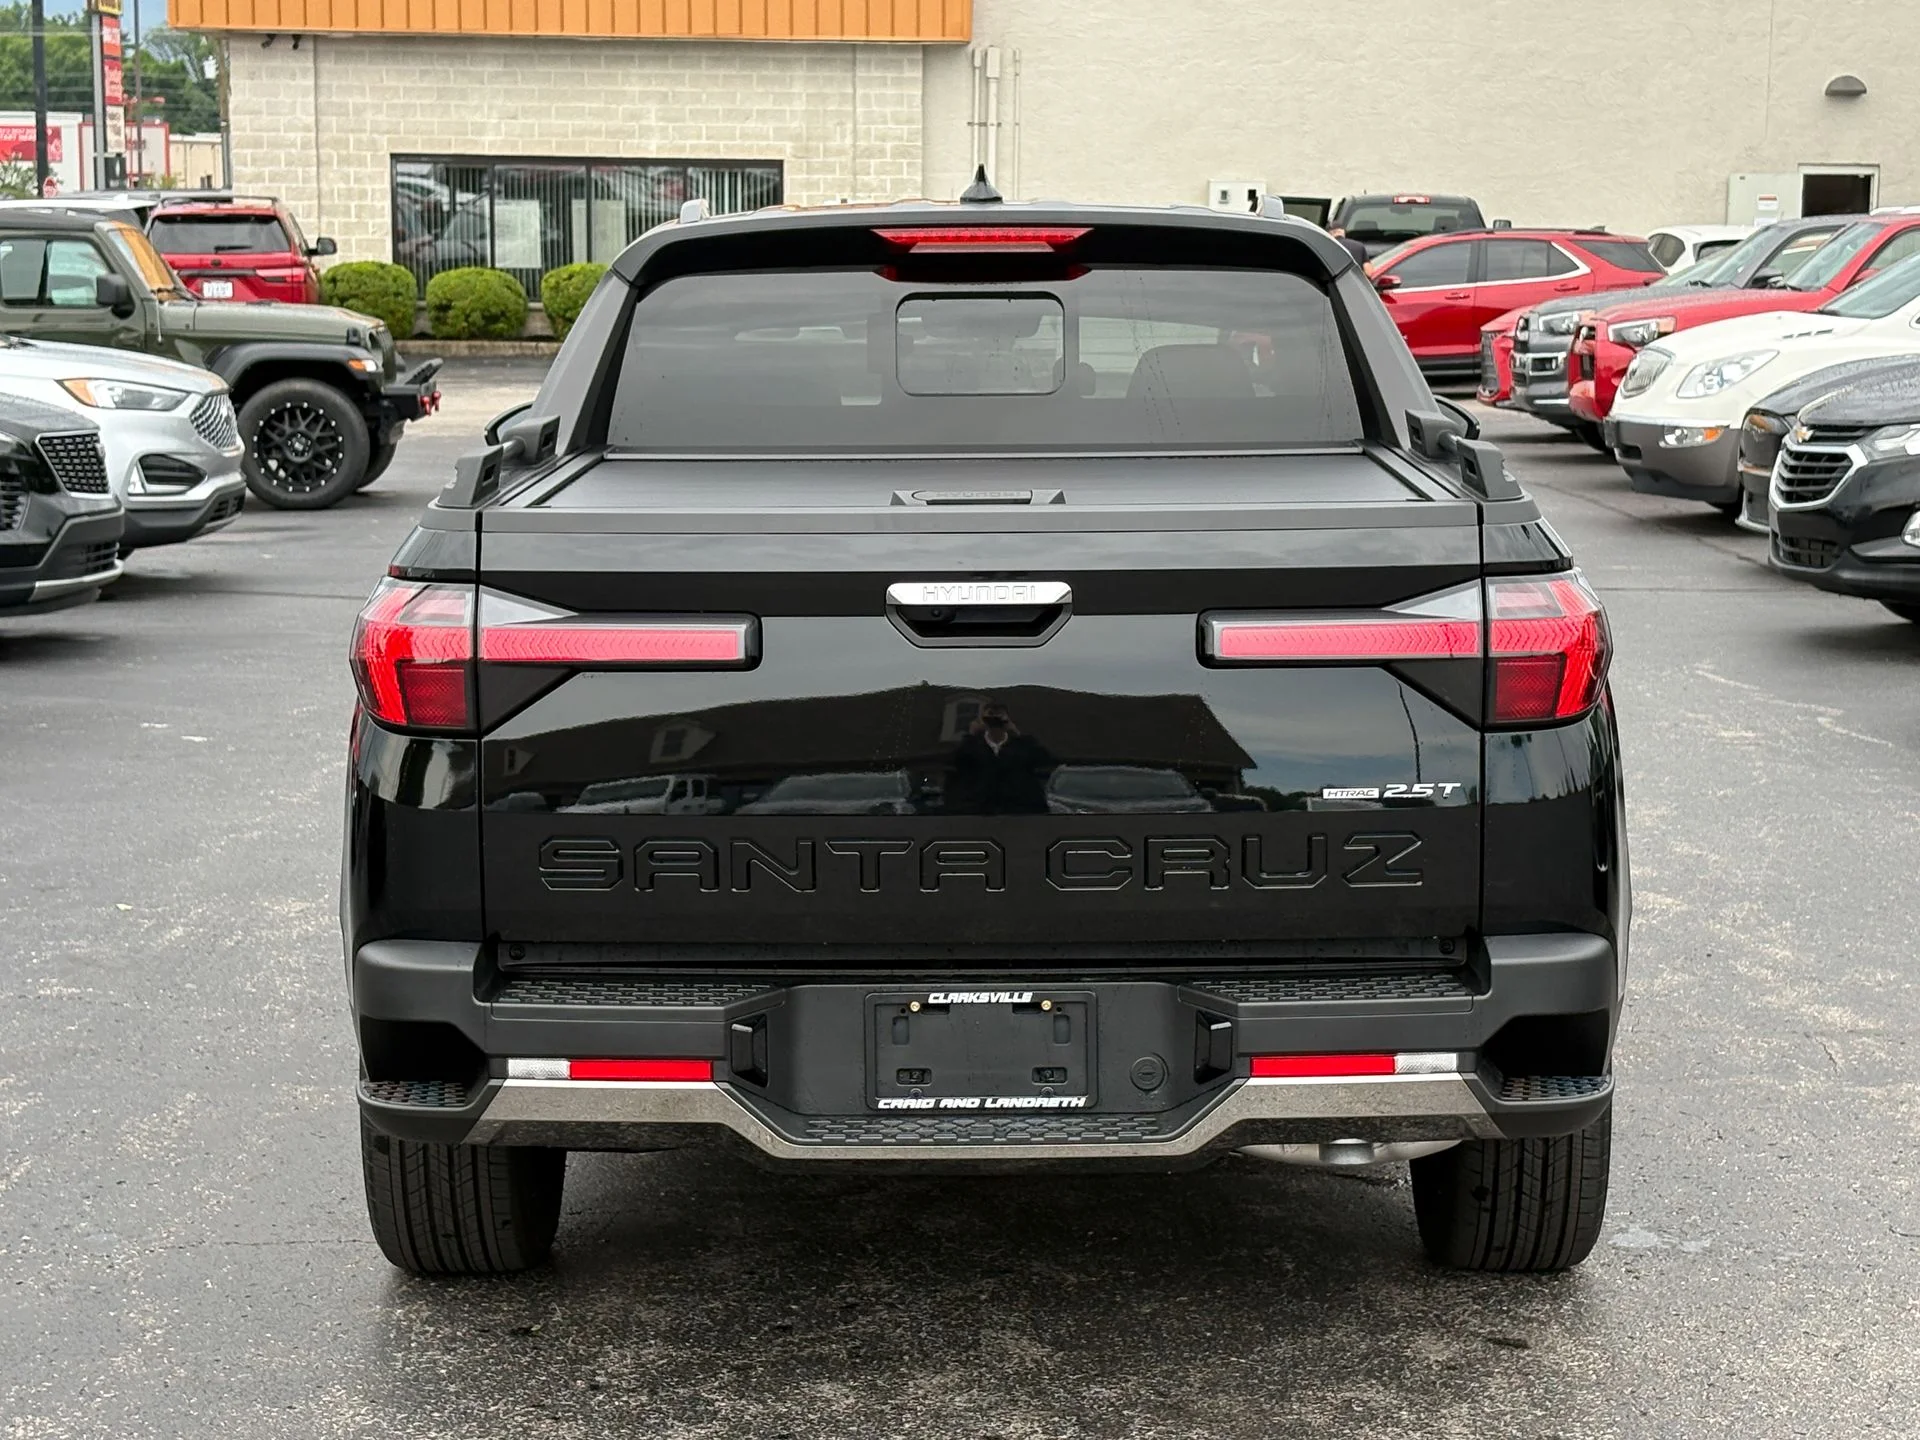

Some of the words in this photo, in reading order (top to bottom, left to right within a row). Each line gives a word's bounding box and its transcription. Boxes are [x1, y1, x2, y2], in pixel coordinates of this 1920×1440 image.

[923, 585, 1035, 601] HYUNDAI
[1327, 789, 1375, 797] HTRAC
[538, 835, 1006, 893] SANTA
[1046, 833, 1423, 891] CRUZ
[928, 992, 1033, 1004] CLARKSVILLE
[877, 1098, 936, 1110] CRAIG
[939, 1098, 981, 1109] AND
